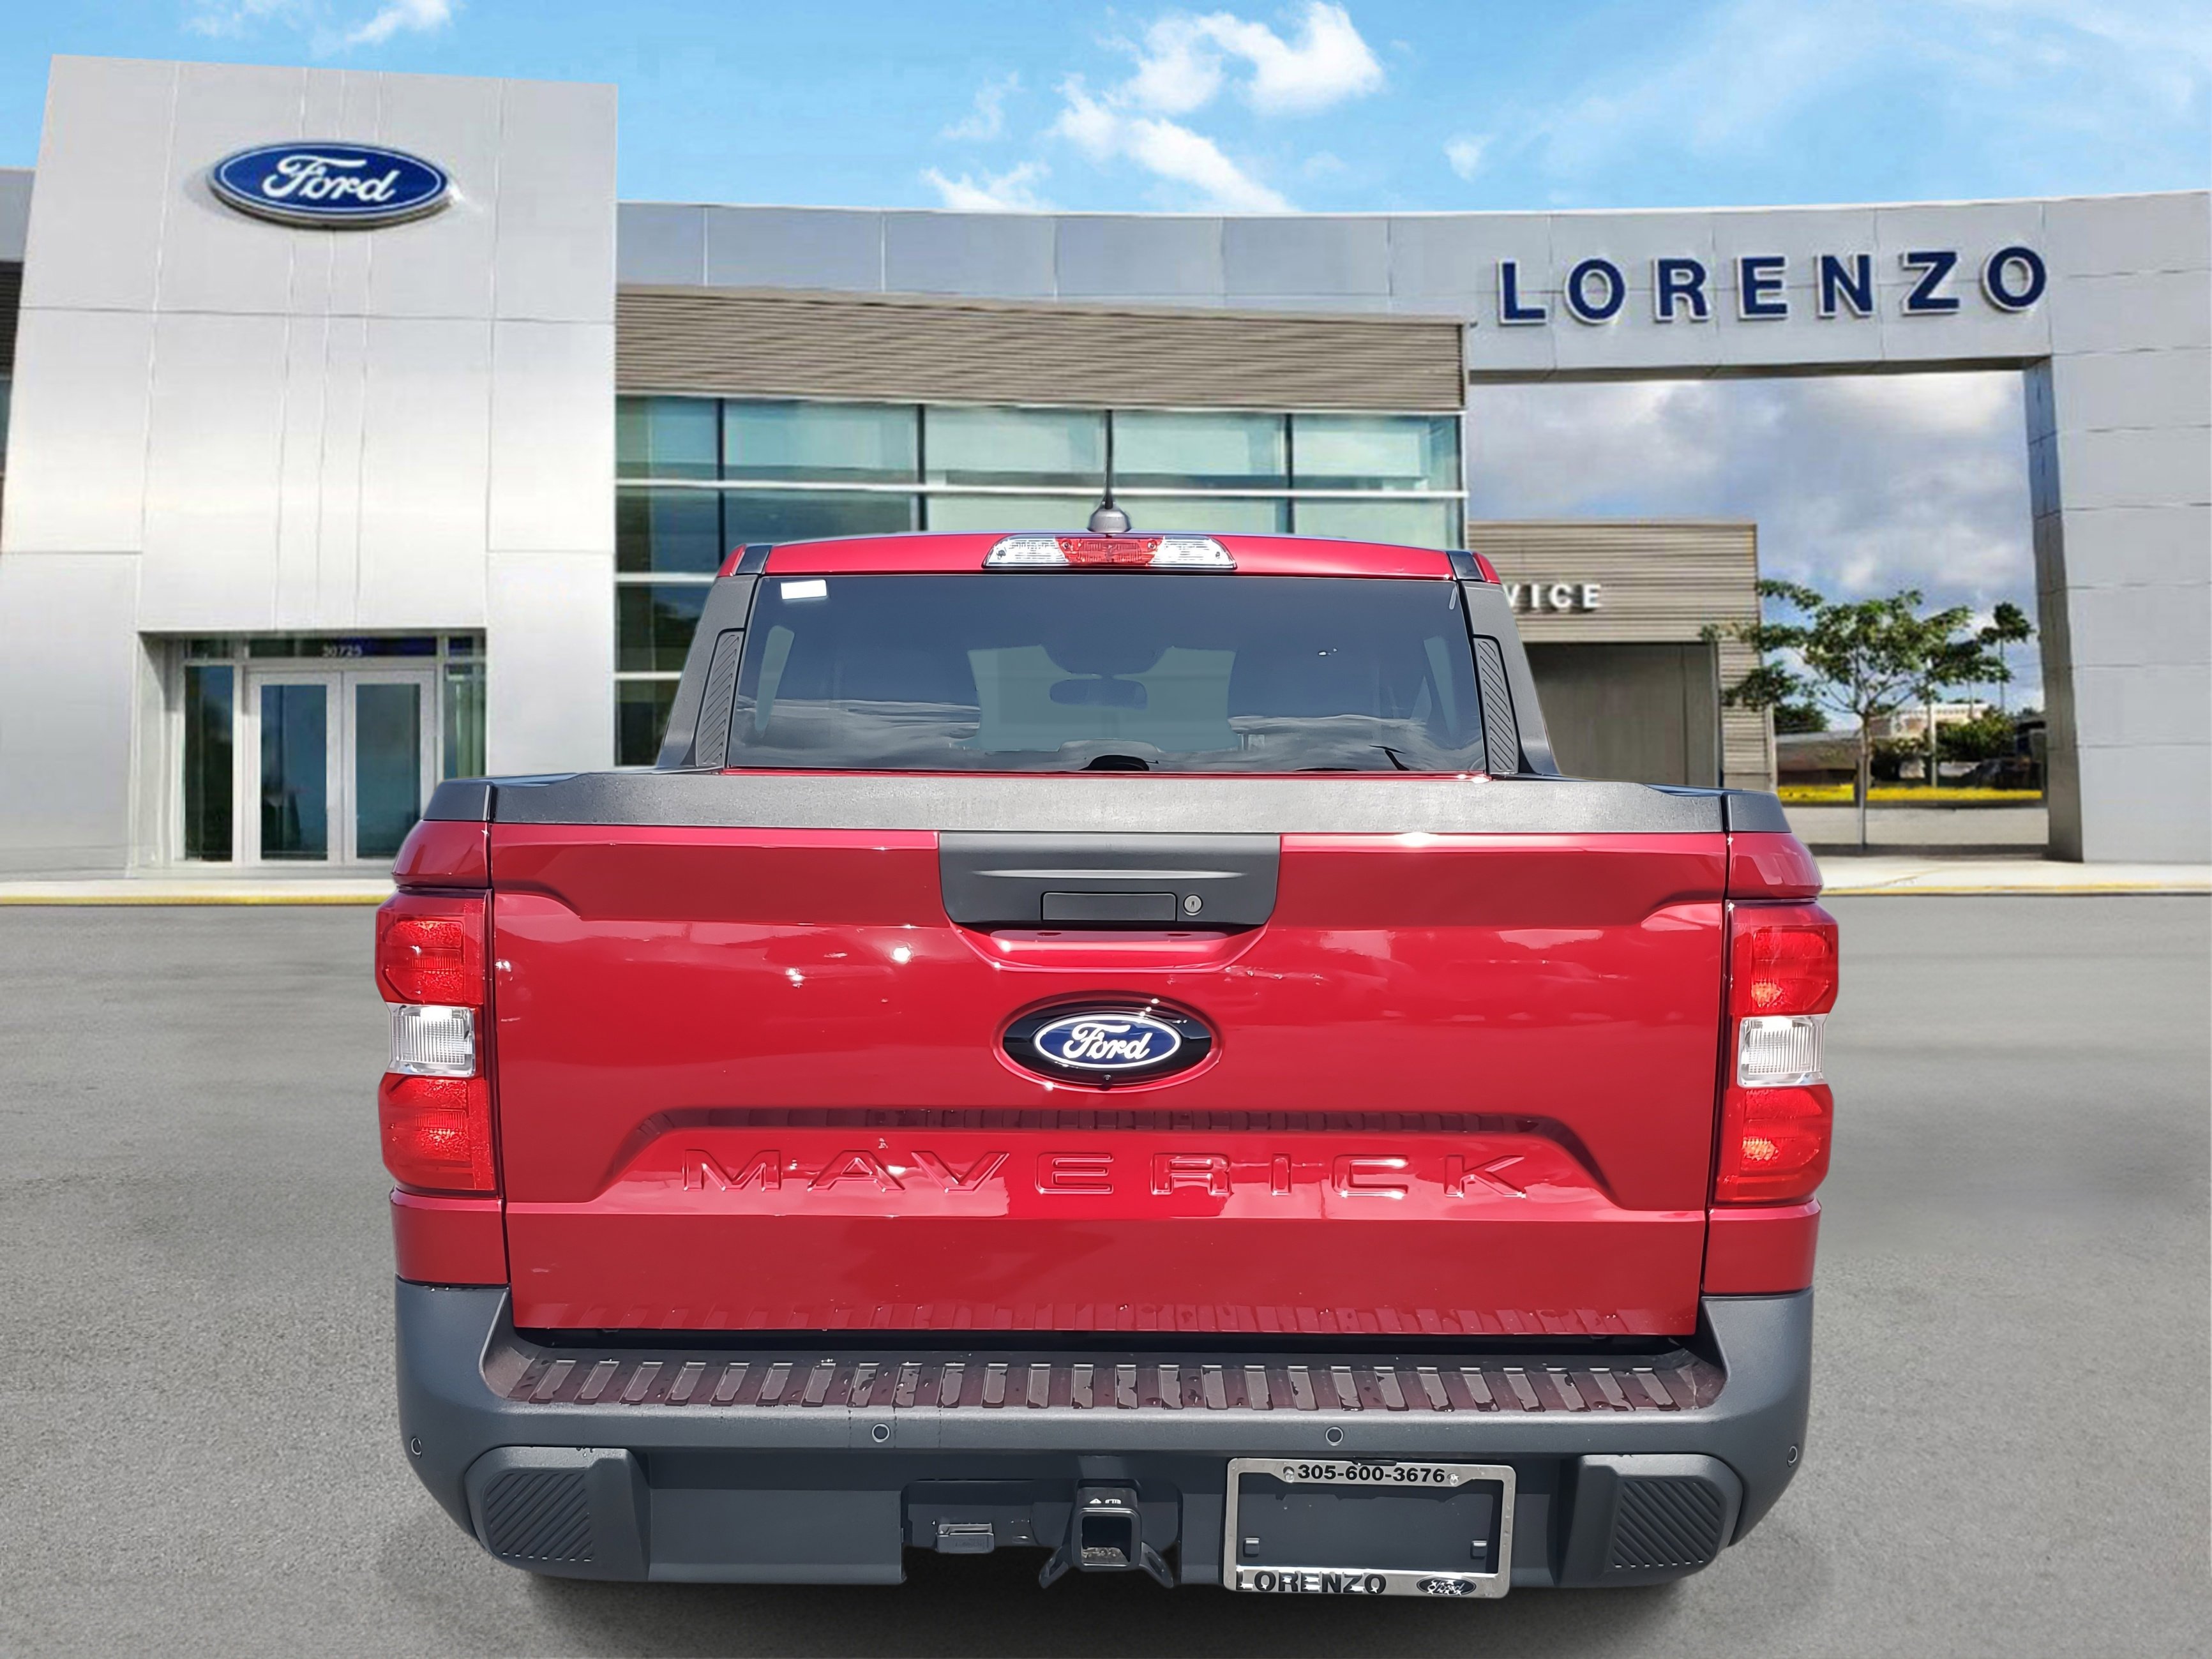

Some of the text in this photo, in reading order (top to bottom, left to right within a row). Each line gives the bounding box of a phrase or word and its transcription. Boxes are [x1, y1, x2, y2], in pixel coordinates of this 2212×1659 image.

[262, 154, 401, 202] Ford
[1496, 246, 2047, 325] LORENZO
[1502, 583, 1602, 608] VICE
[1062, 1022, 1153, 1060] Ford
[682, 1150, 1527, 1199] MAVERICK
[1297, 1464, 1446, 1483] 305-600-3676
[1235, 1570, 1387, 1595] LORENZO
[1427, 1579, 1466, 1595] Ford
